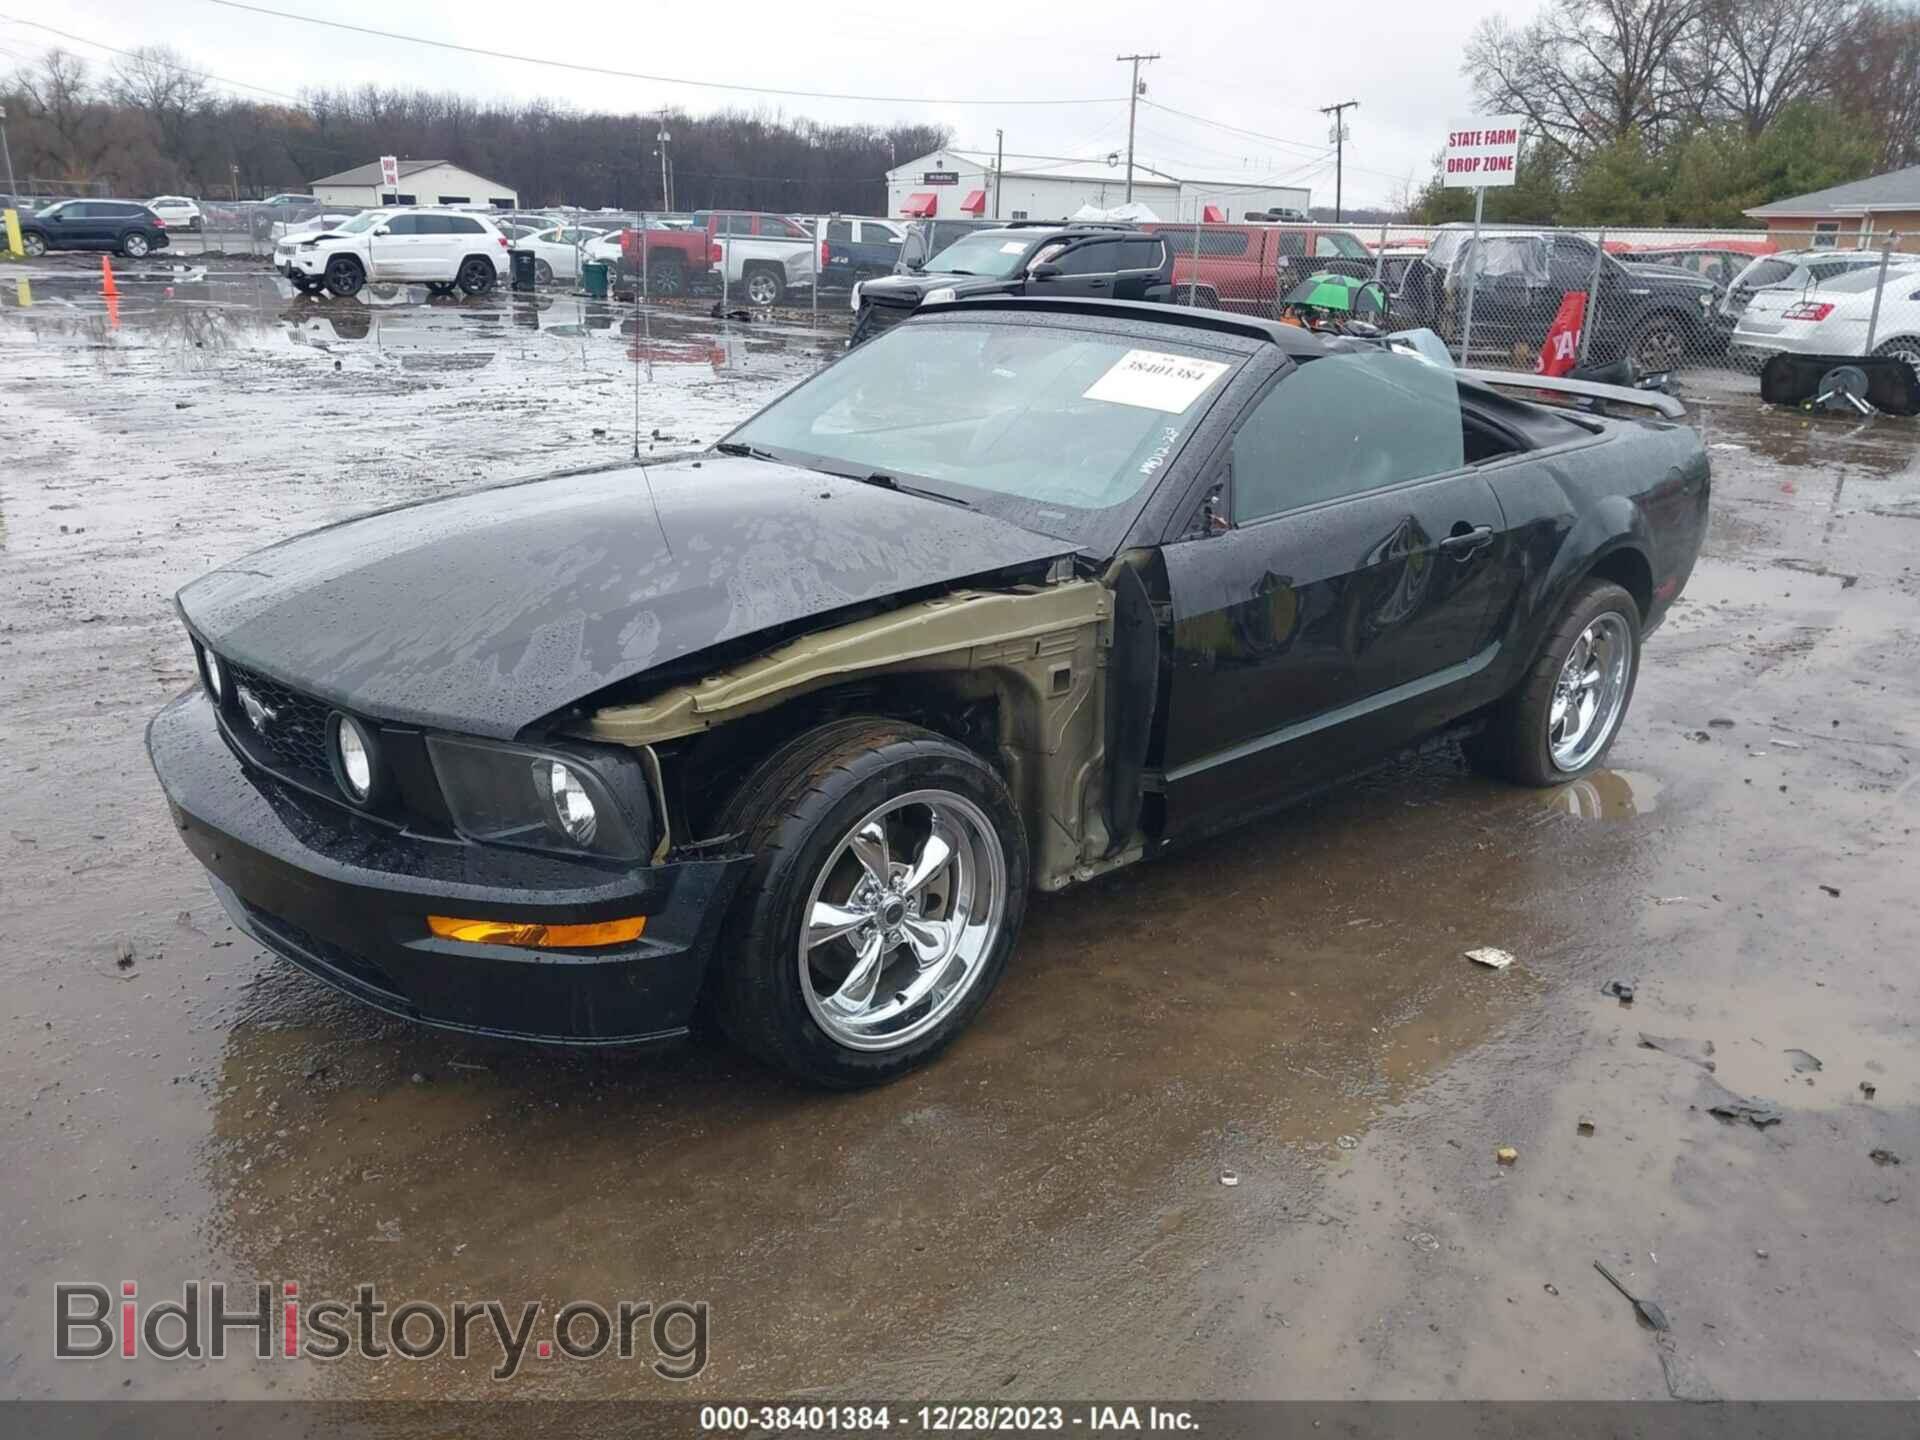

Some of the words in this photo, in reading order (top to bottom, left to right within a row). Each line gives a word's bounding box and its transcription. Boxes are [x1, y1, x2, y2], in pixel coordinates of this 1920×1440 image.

[1449, 131, 1482, 147] STATE
[1485, 129, 1517, 145] FARM
[1447, 157, 1480, 173] DROP
[1483, 155, 1514, 171] ZONE
